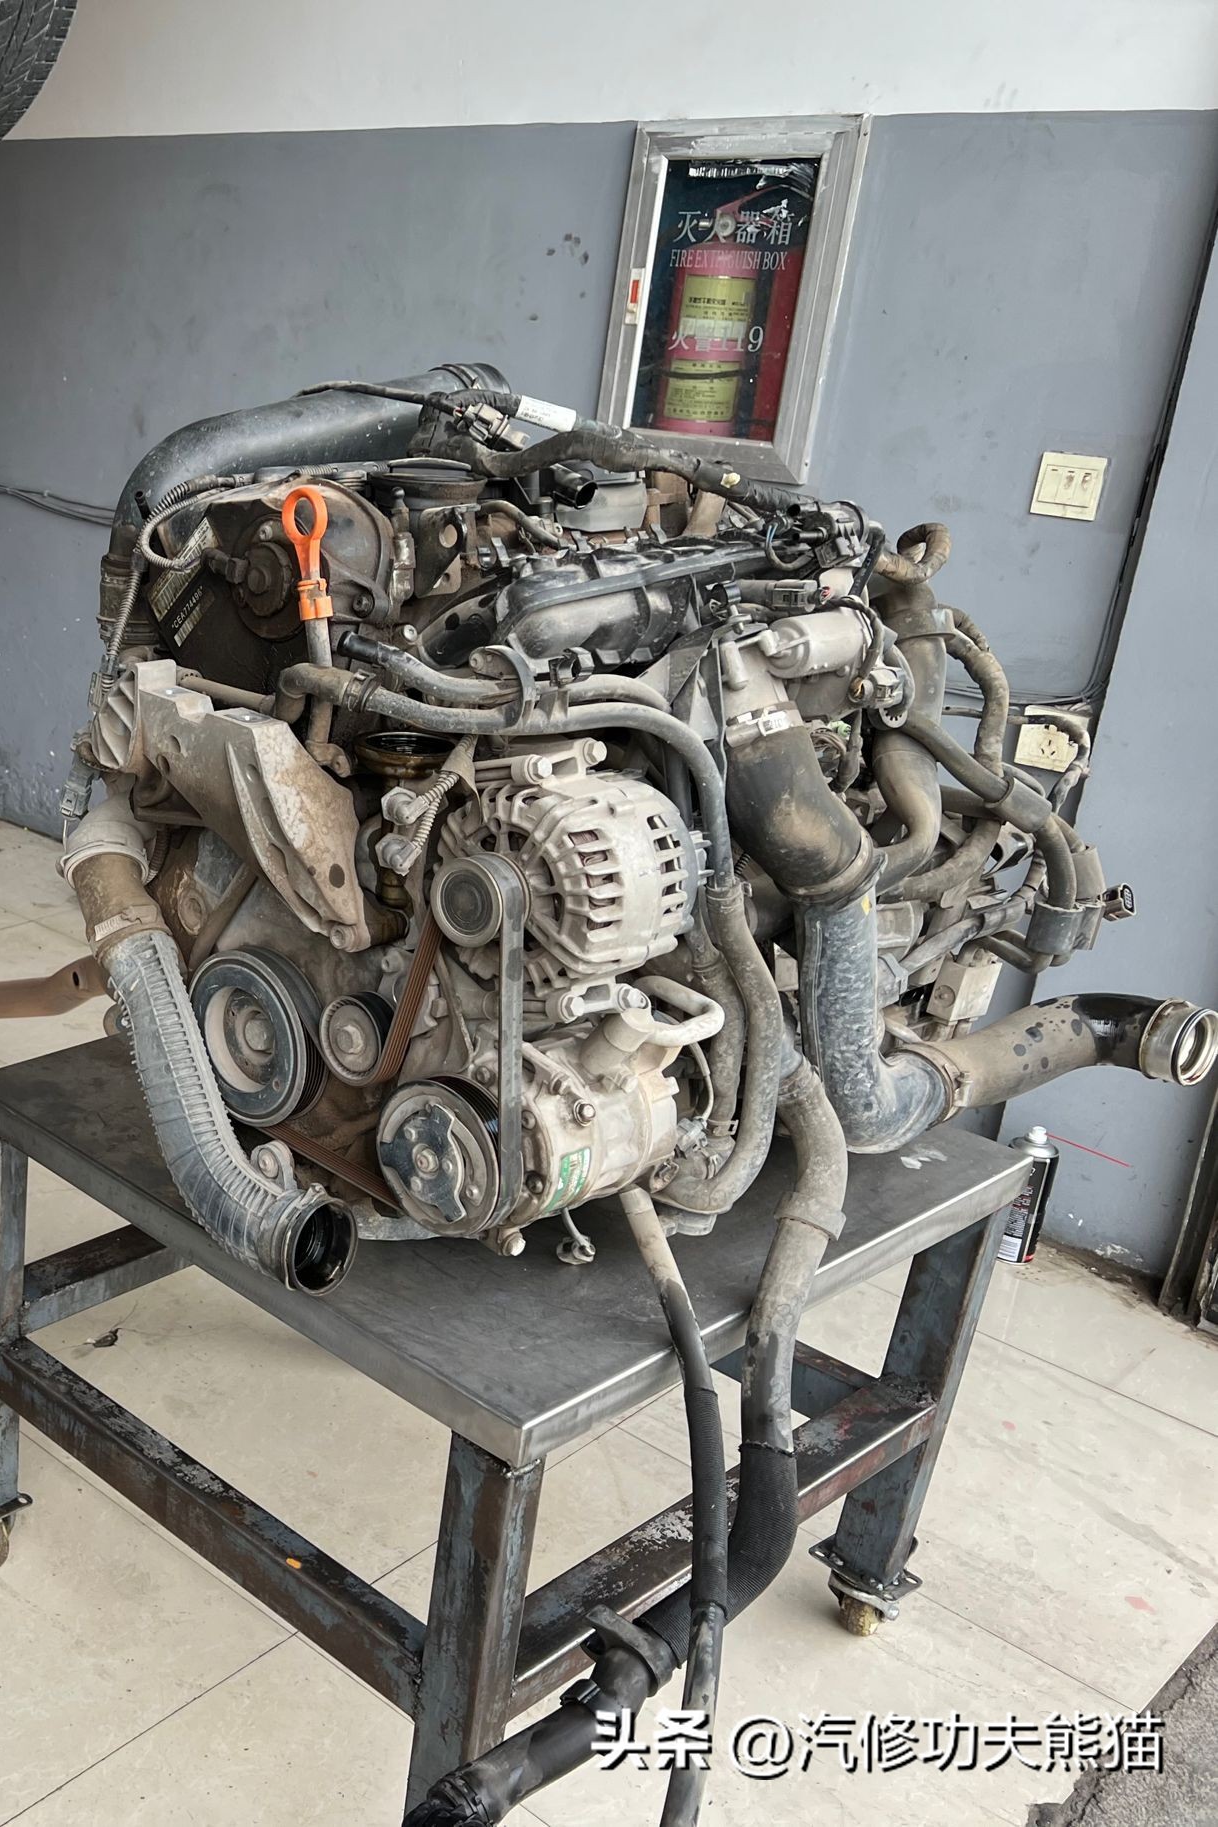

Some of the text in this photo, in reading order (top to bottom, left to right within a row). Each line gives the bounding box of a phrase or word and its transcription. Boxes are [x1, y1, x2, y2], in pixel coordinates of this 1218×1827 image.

[672, 209, 795, 246] 灭火器箱
[670, 249, 693, 268] FIRE
[762, 251, 788, 271] BOX
